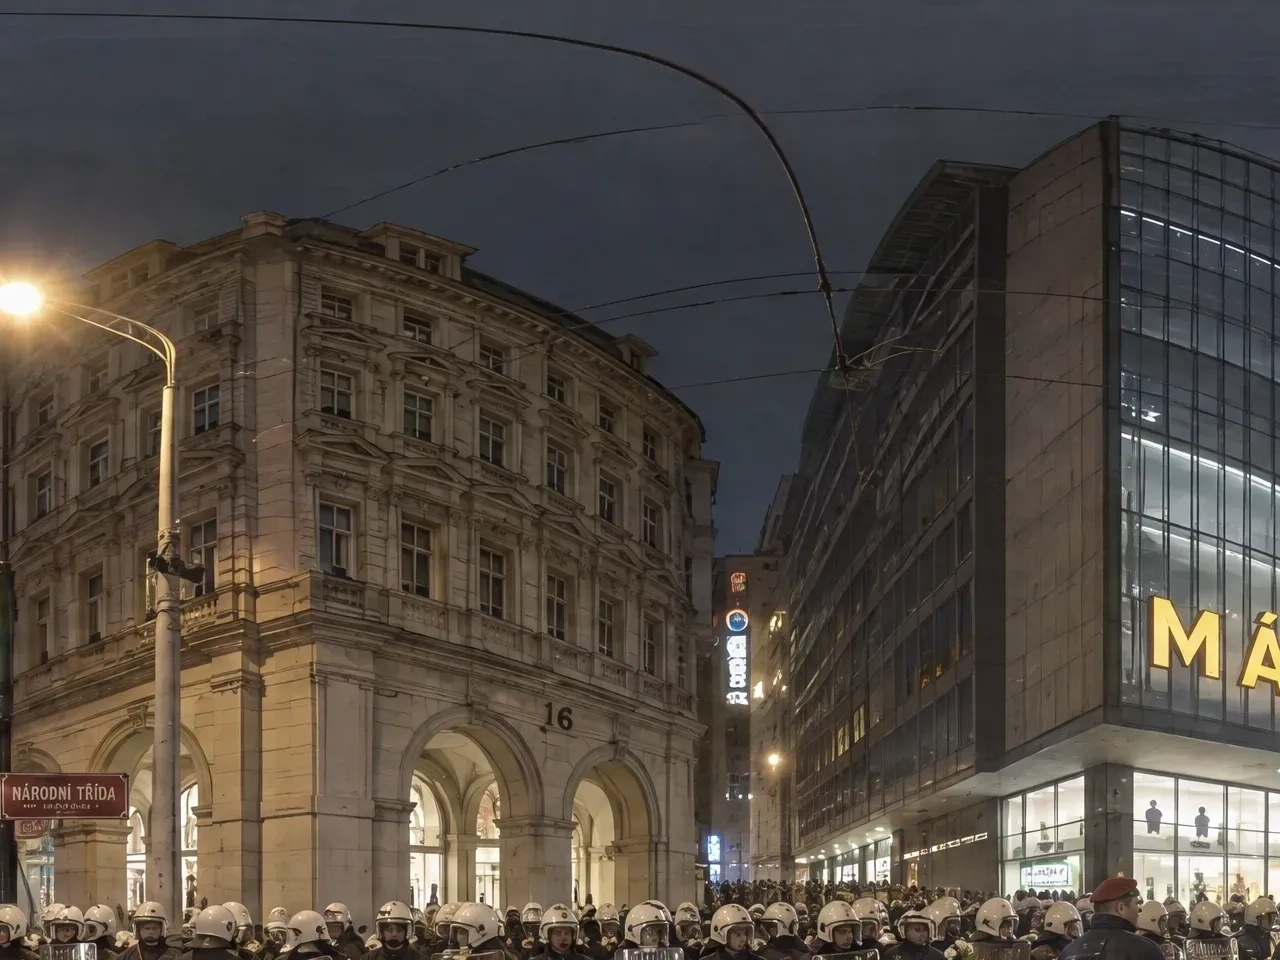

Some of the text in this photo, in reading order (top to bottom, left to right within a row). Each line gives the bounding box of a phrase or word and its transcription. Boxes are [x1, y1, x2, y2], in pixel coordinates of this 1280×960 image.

[543, 701, 573, 731] 16
[12, 783, 116, 801] NÁRODNÍ TŘÍDA
